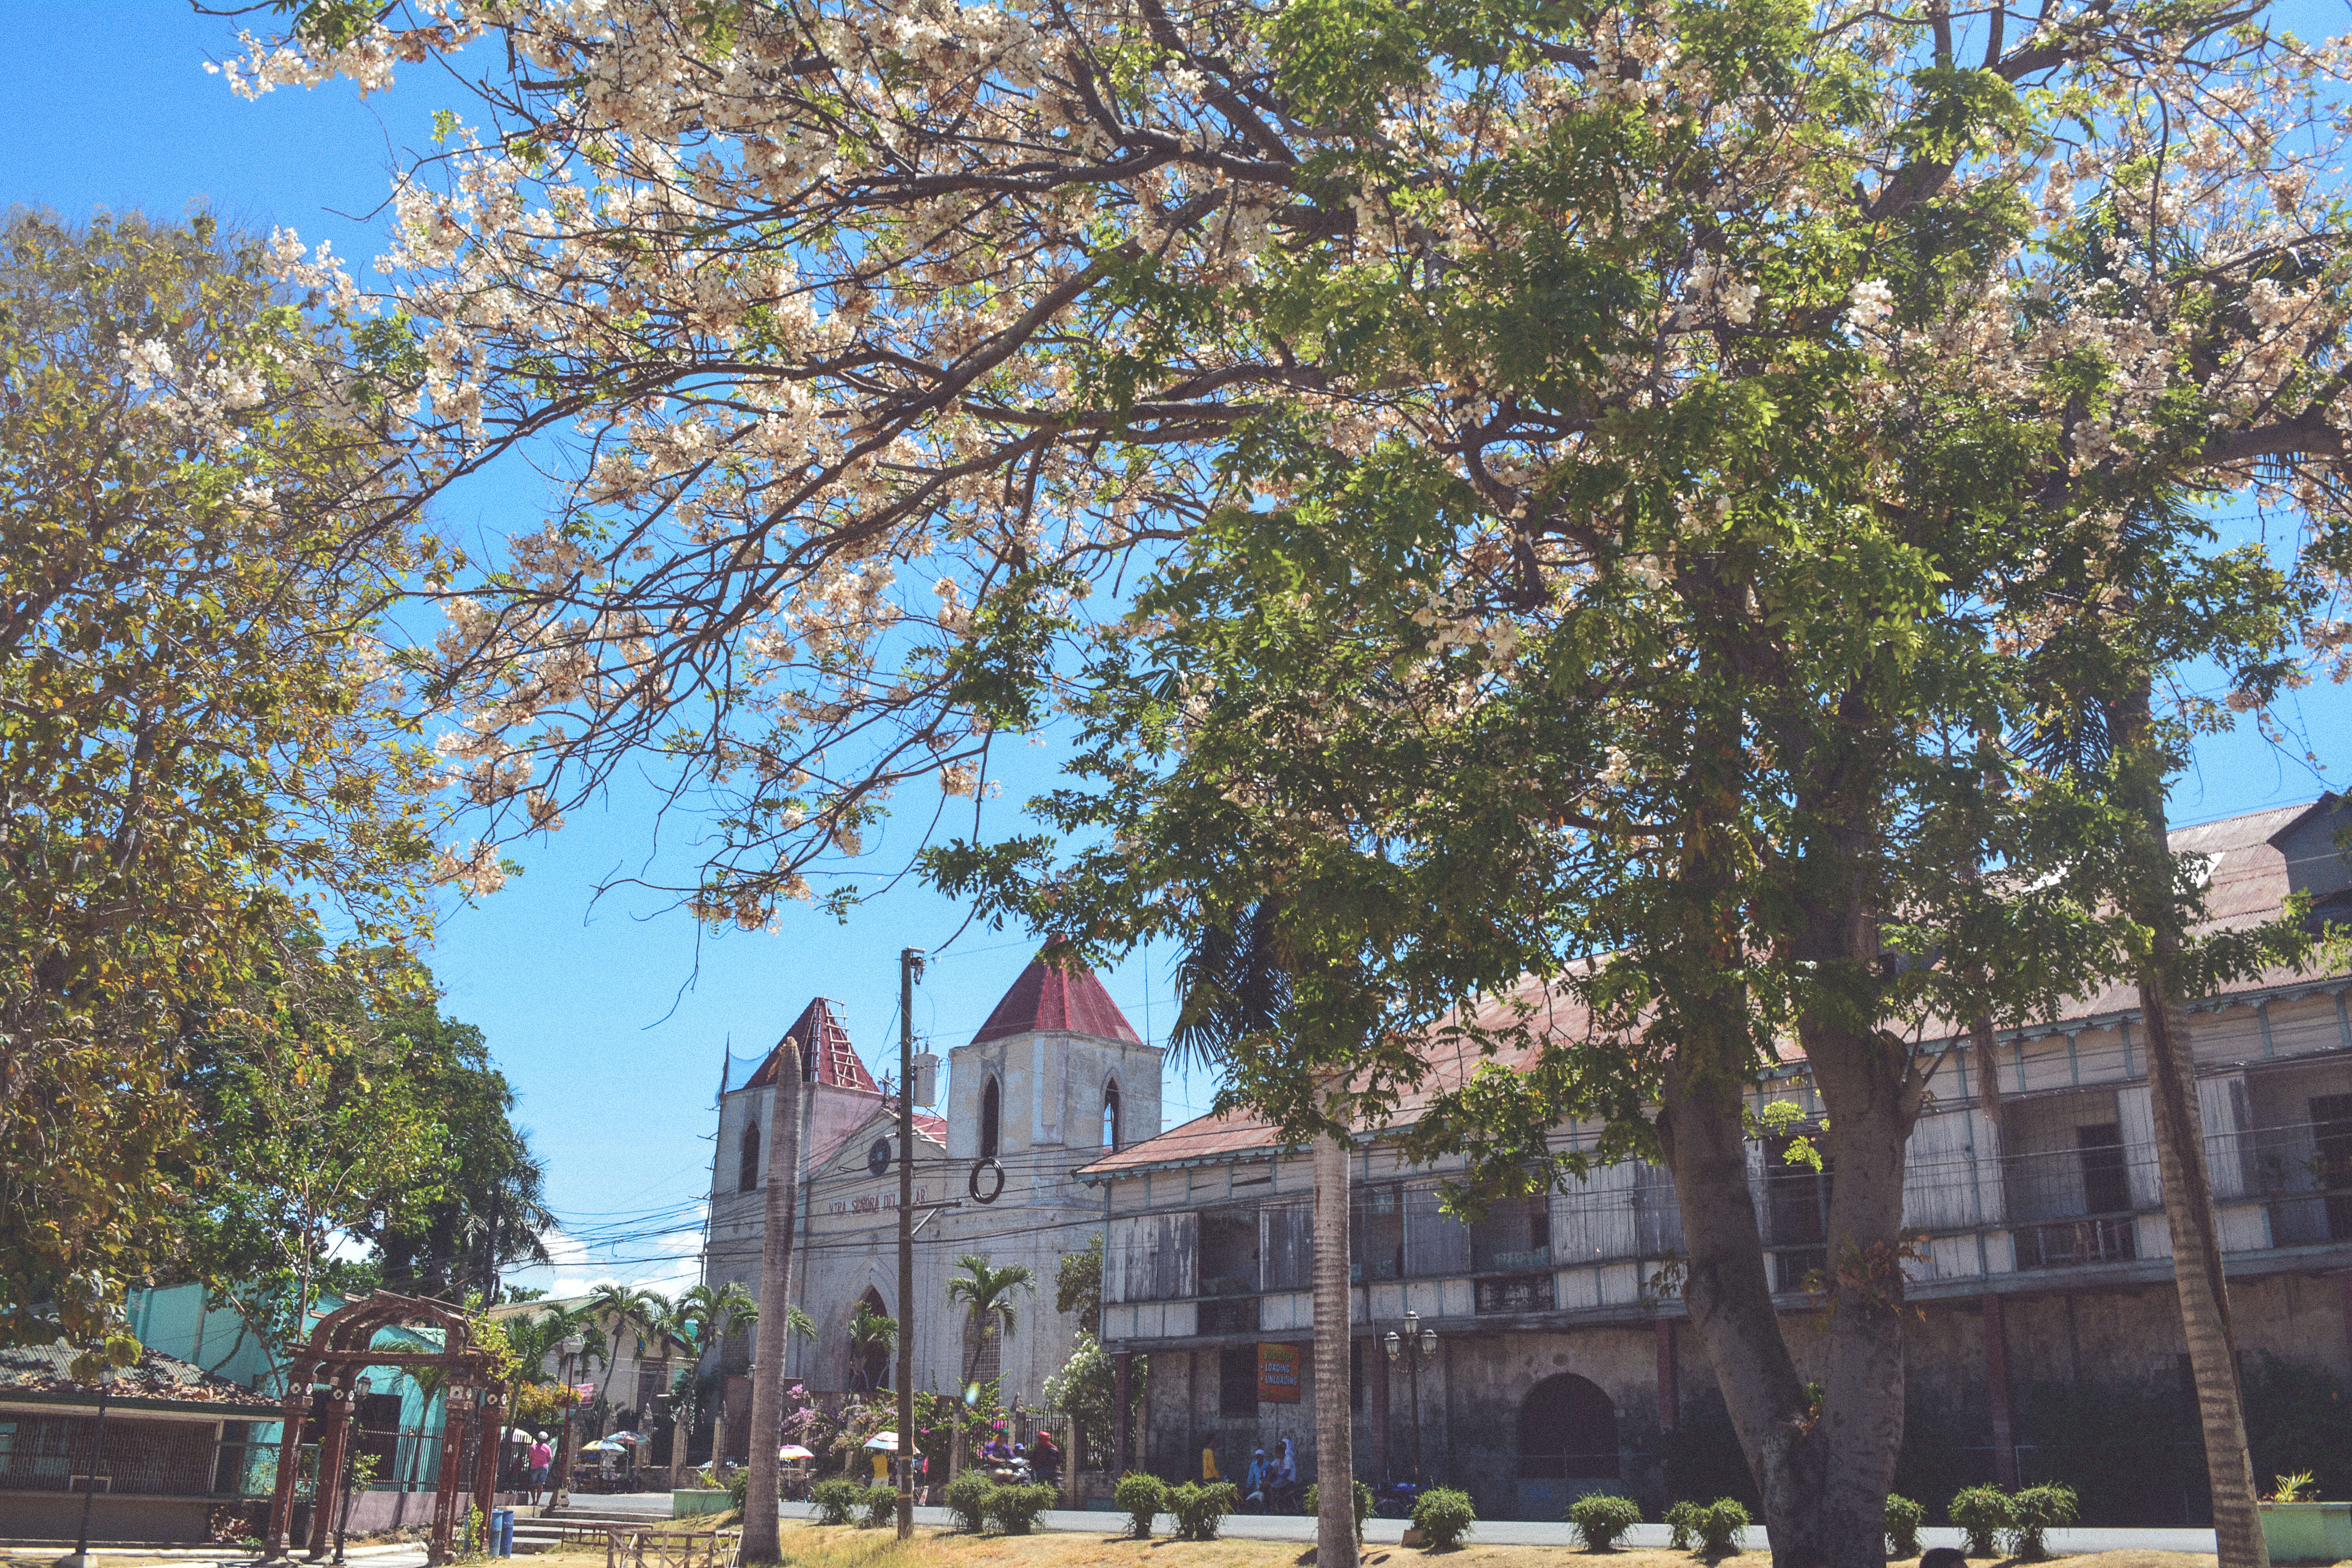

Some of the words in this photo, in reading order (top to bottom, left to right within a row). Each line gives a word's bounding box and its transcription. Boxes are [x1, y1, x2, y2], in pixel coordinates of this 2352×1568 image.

[883, 1193, 896, 1210] DEL
[1263, 1350, 1276, 1360] BUS
[1278, 1351, 1294, 1361] STOP
[1265, 1363, 1290, 1373] LOADING
[1265, 1375, 1297, 1386] UNLOADING
